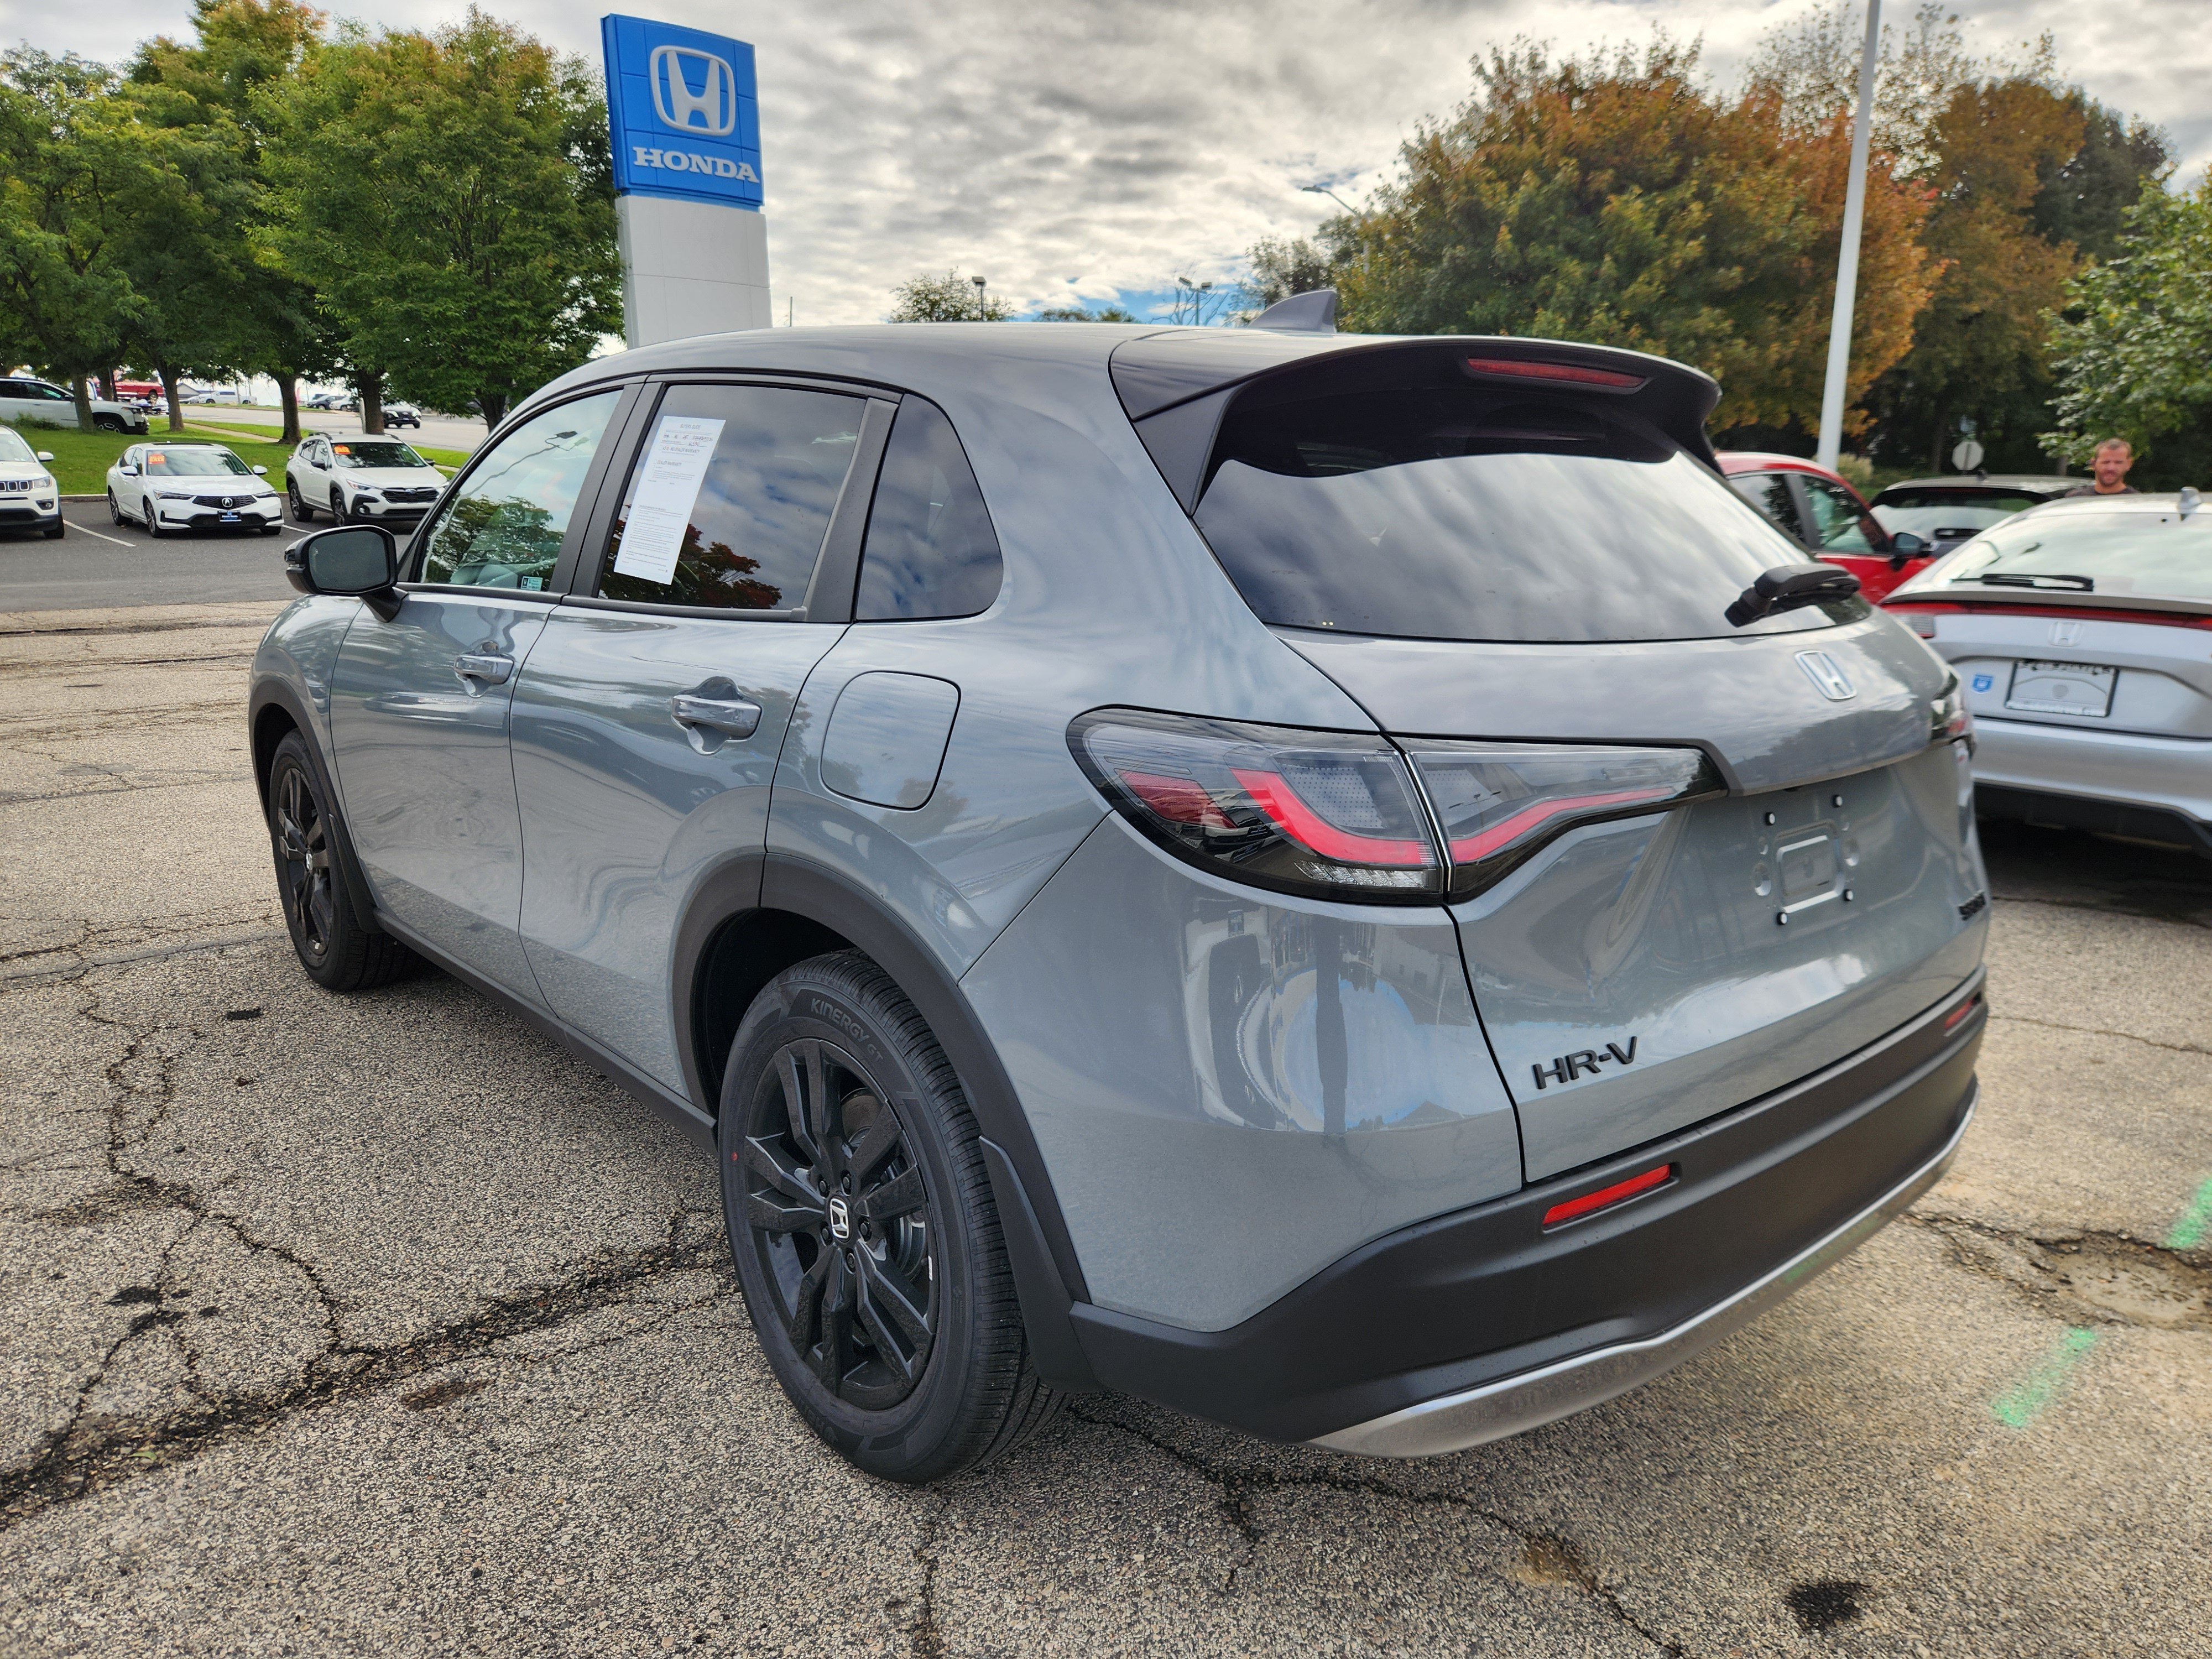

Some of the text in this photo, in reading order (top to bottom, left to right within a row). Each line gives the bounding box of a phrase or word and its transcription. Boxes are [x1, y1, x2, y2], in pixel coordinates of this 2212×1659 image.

[633, 147, 760, 183] HONDA
[811, 998, 883, 1062] KINERGY GT
[1532, 1036, 1637, 1089] HR-V
